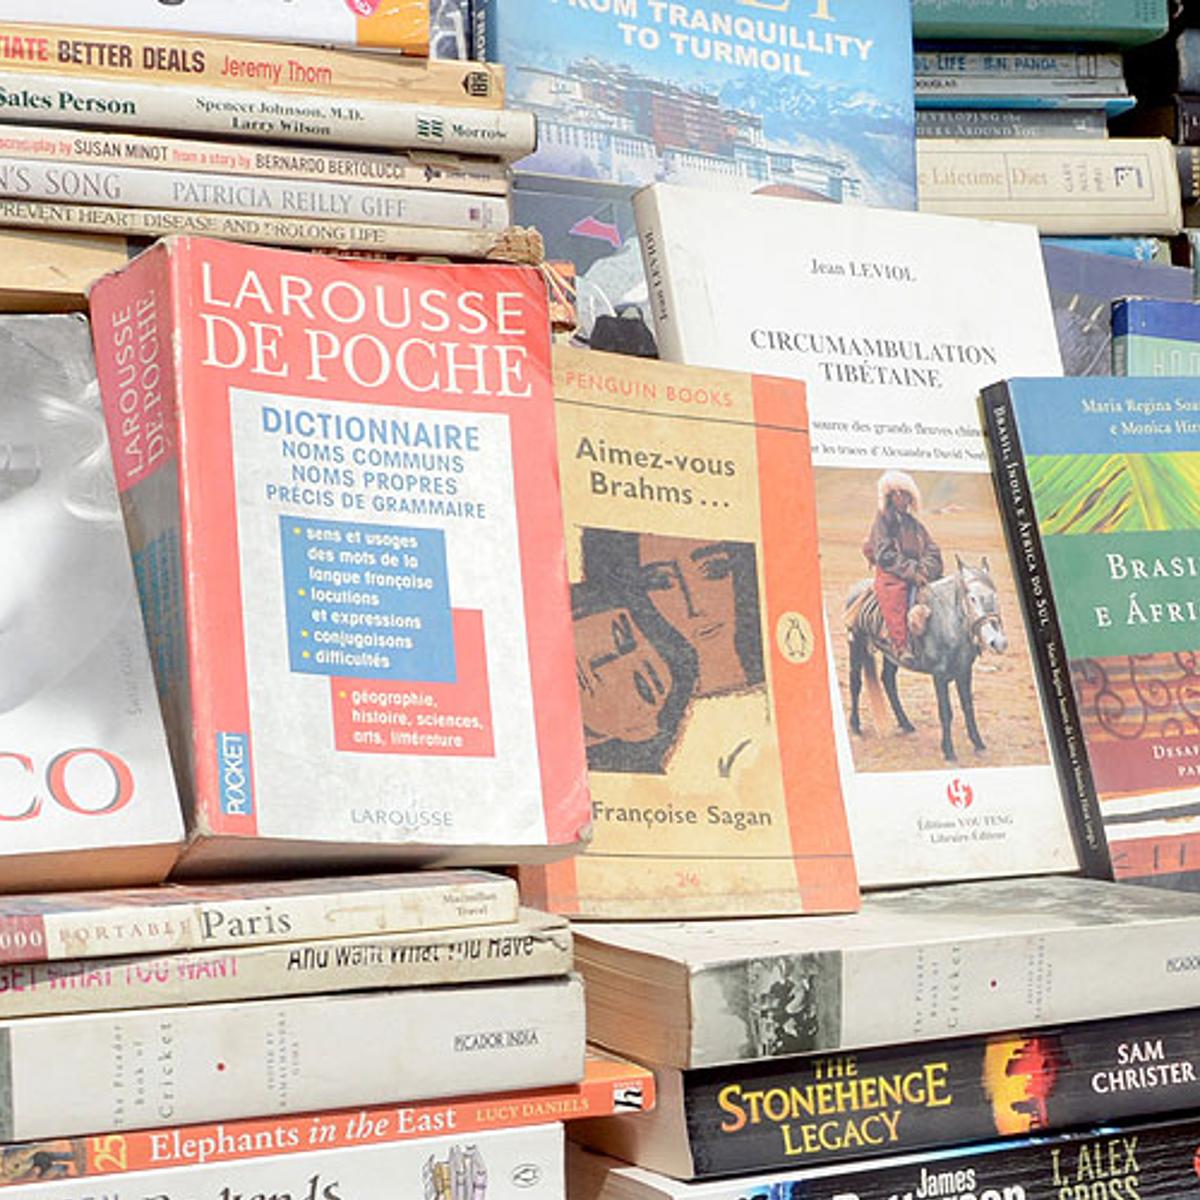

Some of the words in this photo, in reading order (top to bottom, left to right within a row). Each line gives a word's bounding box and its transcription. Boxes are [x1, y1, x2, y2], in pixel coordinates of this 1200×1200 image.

[648, 0, 873, 60] TRANQUILLITY
[58, 41, 132, 68] BETTER
[143, 46, 205, 73] DEALS
[219, 55, 281, 80] Jeremy
[287, 60, 332, 83] Thorn
[617, 23, 658, 50] TO
[680, 33, 812, 77] TURMOIL
[1014, 58, 1058, 71] PANDA
[58, 92, 136, 115] Person
[196, 98, 252, 115] Spencer
[232, 117, 274, 133] Larry
[280, 119, 331, 135] Wilson
[452, 124, 507, 139] Morrow
[74, 139, 121, 158] SUSAN
[126, 143, 168, 162] MINOT
[256, 154, 324, 174] BERNARDO
[329, 162, 405, 179] BERTOLUCCI
[46, 171, 121, 200] SONG
[174, 182, 272, 210] PATRICIA
[283, 189, 354, 213] REILLY
[362, 193, 407, 217] GIFF
[79, 206, 134, 226] HEART
[145, 213, 216, 231] DISEASE
[811, 259, 845, 275] Jean
[851, 262, 917, 281] LEVIOL
[202, 262, 526, 335] LAROUSSE
[200, 312, 289, 377] DE
[305, 328, 532, 397] POCHE
[751, 330, 997, 364] CIRCUMAMBULATION
[565, 372, 657, 398] PENGUIN
[667, 386, 733, 407] BOOKS
[819, 360, 941, 388] TIBÉTAINE
[111, 306, 145, 478] LAROUSSE
[1127, 399, 1170, 415] Regina
[263, 406, 479, 452] DICTIONNAIRE
[1122, 421, 1170, 436] Monica
[282, 440, 344, 464] NOMS
[353, 448, 464, 474] COMMUNS
[575, 437, 735, 478] Aimez-vous
[292, 464, 355, 487] NOMS
[364, 471, 457, 496] PROPRES
[266, 483, 333, 509] PRÉCIS
[374, 496, 485, 520] GRAMMAIRE
[311, 588, 379, 606] locutions
[365, 572, 432, 592] française
[331, 612, 421, 632] expressions
[314, 631, 413, 650] conjugaisons
[316, 652, 389, 669] difficultés
[416, 713, 484, 730] sciences,
[221, 732, 246, 815] POCKET
[351, 808, 453, 827] LAROUSSE
[592, 801, 697, 830] Françoise
[707, 805, 772, 831] Sagan
[202, 906, 292, 939] Paris
[454, 1033, 503, 1052] PICADOR
[1118, 1041, 1164, 1064] SAM
[158, 1022, 173, 1119] Cricket
[1091, 1061, 1196, 1093] CHRISTER
[719, 1062, 952, 1131] STONEHENGE
[149, 1125, 299, 1164] Elephants
[308, 1119, 336, 1142] in
[345, 1112, 389, 1139] the
[397, 1106, 457, 1134] East
[475, 1103, 520, 1122] LUCY
[523, 1098, 589, 1118] DANIELS
[783, 1110, 902, 1155] LEGACY
[1077, 1135, 1140, 1178] ALEX
[917, 1167, 976, 1199] James
